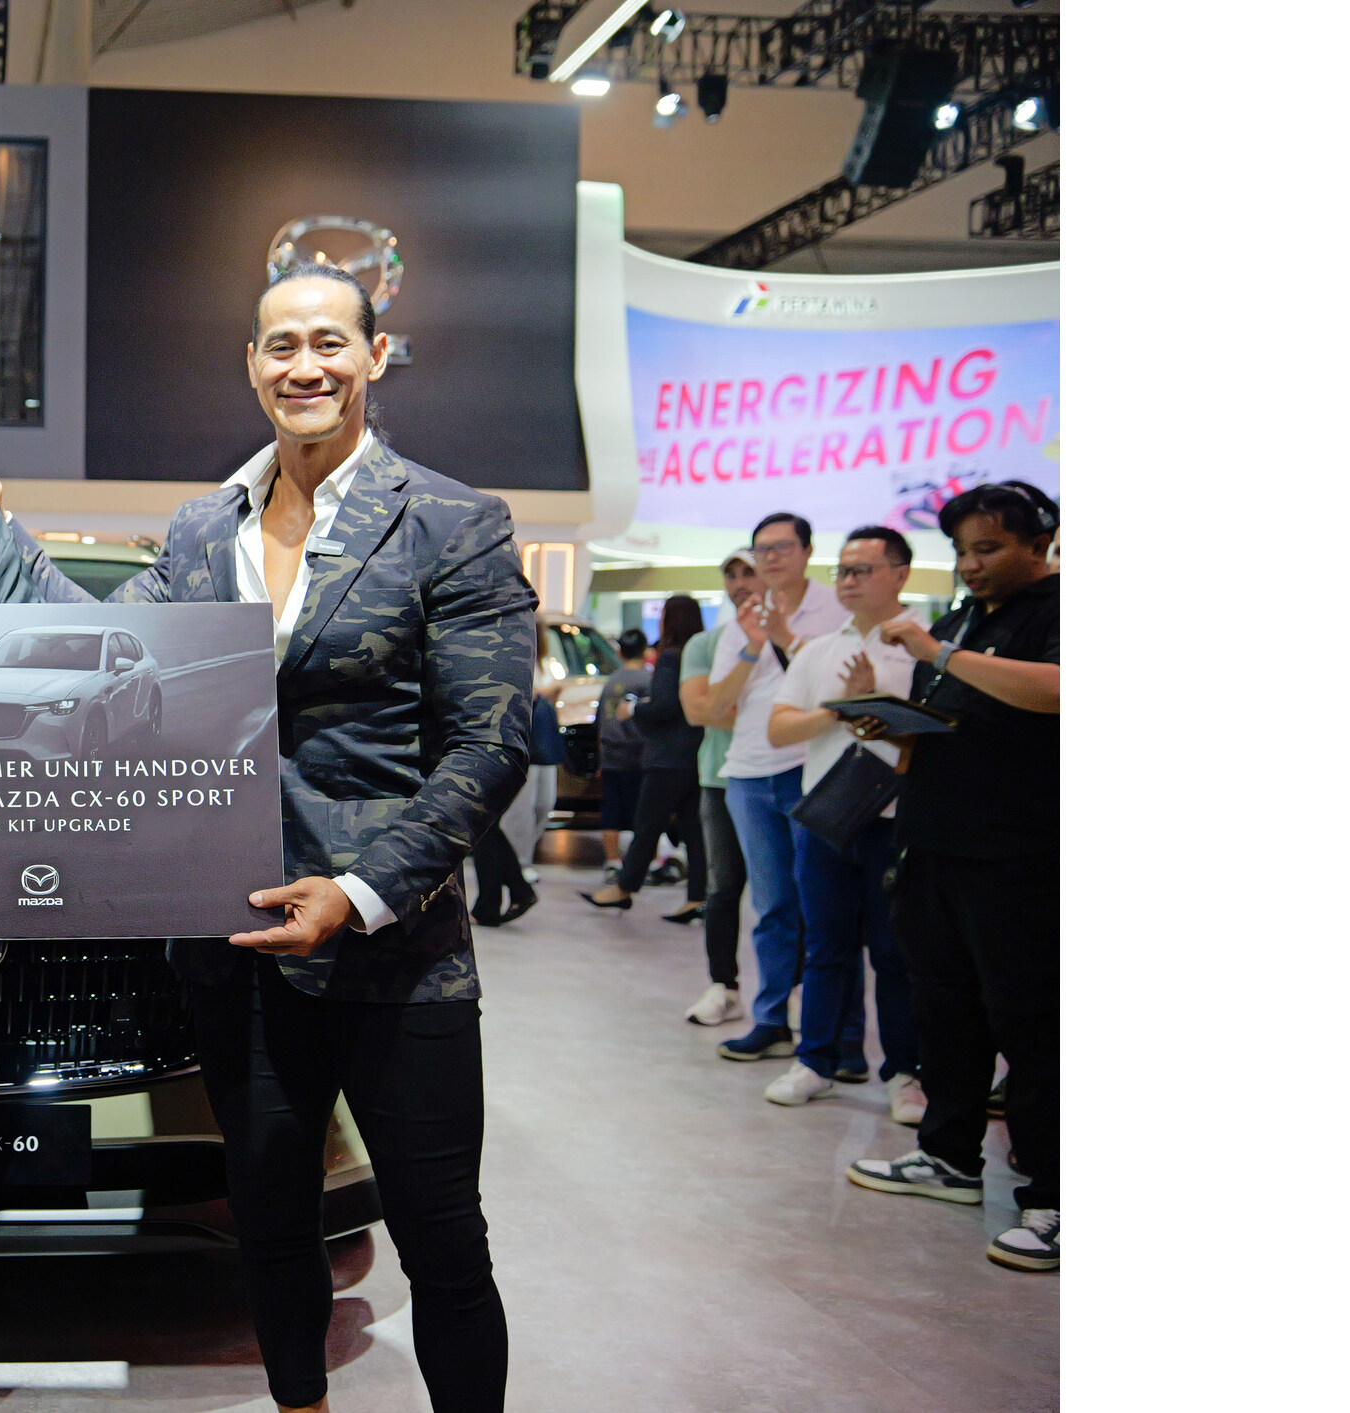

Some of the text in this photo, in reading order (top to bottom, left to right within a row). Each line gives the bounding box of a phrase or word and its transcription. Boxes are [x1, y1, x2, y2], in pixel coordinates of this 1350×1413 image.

[655, 346, 998, 430] ENERGIZING
[659, 397, 1051, 485] ACCELERATION
[45, 760, 104, 778] UNIT
[115, 758, 258, 777] HANDOVER
[70, 789, 146, 808] CX-60
[157, 788, 235, 807] SPORT
[8, 818, 35, 832] KIT
[44, 817, 132, 832] UPGRADE
